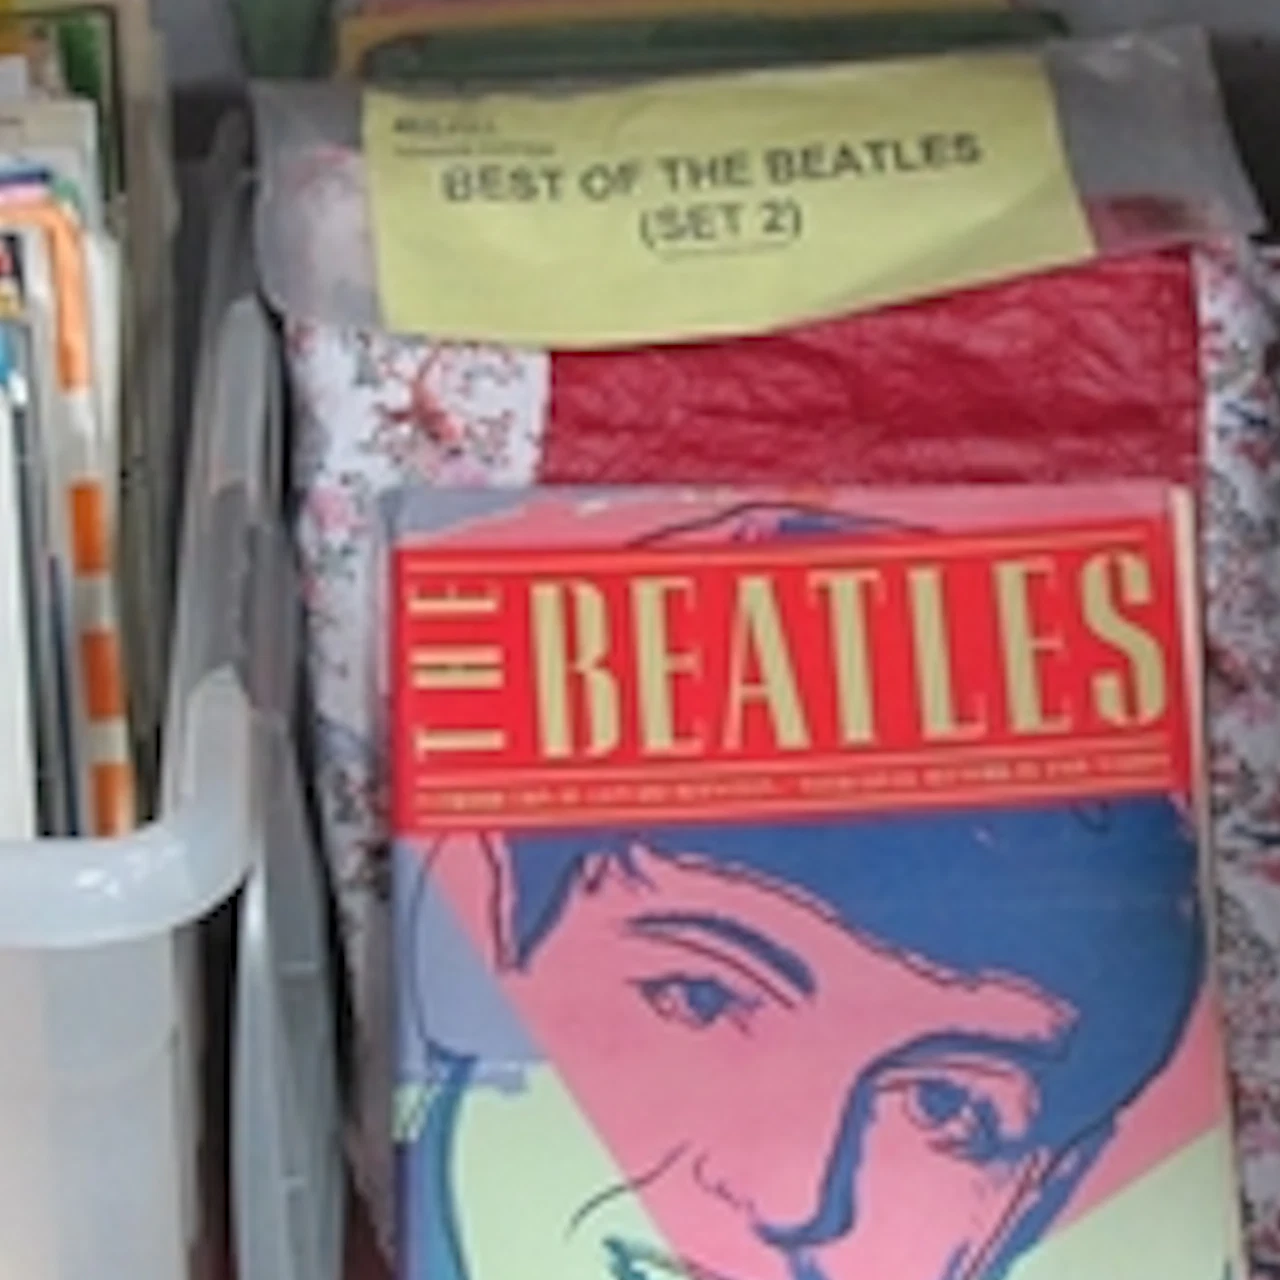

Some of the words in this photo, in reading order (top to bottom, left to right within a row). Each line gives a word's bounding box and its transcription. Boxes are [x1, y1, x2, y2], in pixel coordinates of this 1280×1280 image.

[441, 162, 567, 204] BEST
[578, 157, 642, 201] OF
[658, 148, 754, 193] THE
[764, 131, 984, 187] BEATLES
[637, 202, 746, 250] (SET
[758, 196, 806, 240] 2)
[406, 580, 507, 763] THE
[528, 549, 1169, 761] BEATLES
